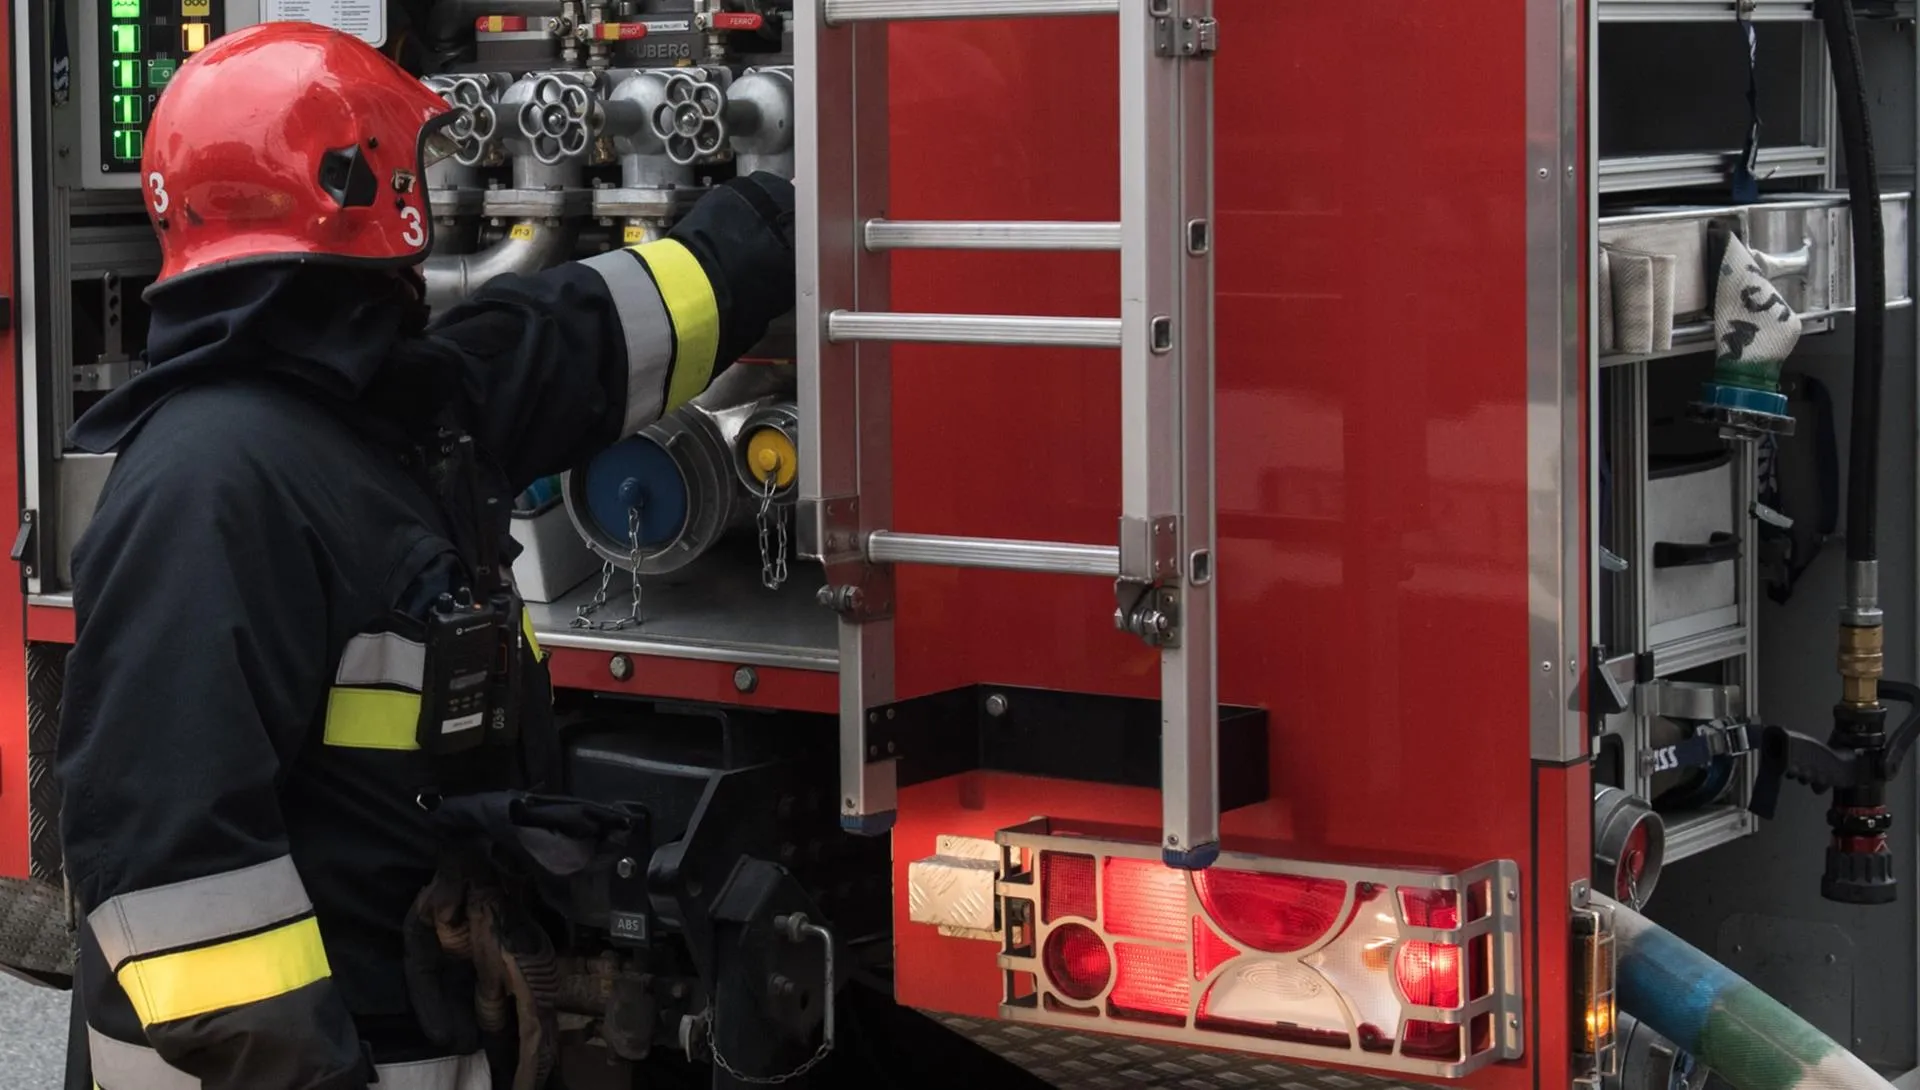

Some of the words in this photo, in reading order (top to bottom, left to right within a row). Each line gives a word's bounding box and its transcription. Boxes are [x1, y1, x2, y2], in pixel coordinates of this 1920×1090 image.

[728, 16, 753, 26] FERRO
[149, 172, 169, 214] 3
[400, 206, 423, 247] 3
[617, 918, 640, 932] ABS
